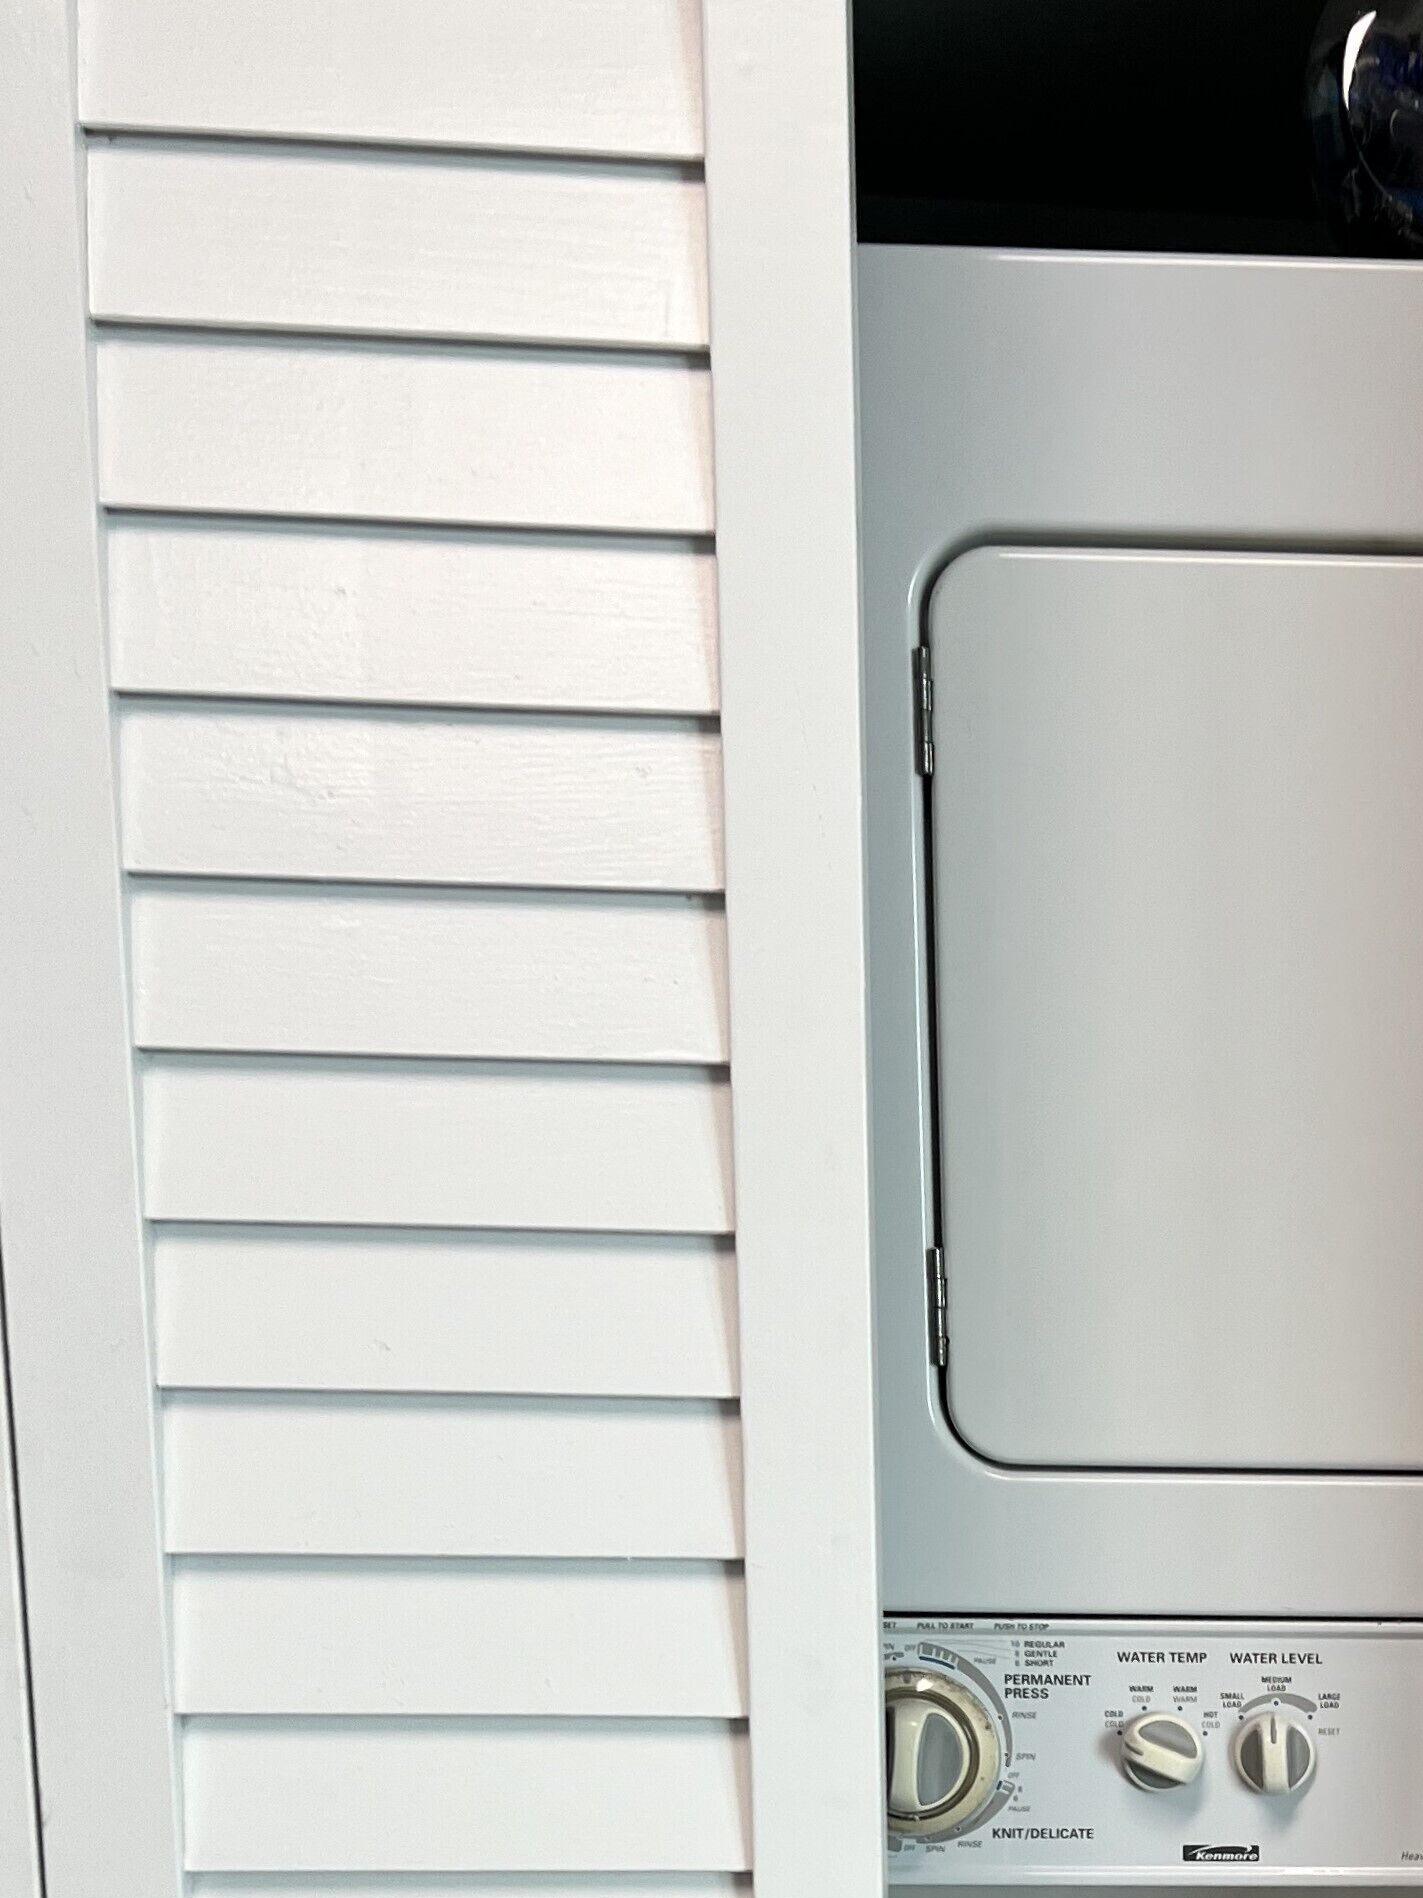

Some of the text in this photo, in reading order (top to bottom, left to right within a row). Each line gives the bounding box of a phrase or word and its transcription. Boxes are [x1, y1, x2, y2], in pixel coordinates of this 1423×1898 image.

[917, 1622, 974, 1630] PULL TO START
[1024, 1650, 1058, 1658] GENTLE
[1117, 1651, 1208, 1663] WATER TEMP
[1229, 1652, 1323, 1664] WATER LEVEL
[1024, 1659, 1054, 1667] SHORT
[1004, 1674, 1092, 1686] PERMANENT
[1261, 1676, 1292, 1684] MEDIUM
[1129, 1685, 1154, 1693] WARM
[1173, 1685, 1198, 1693] WARM
[1004, 1688, 1050, 1699] PRESS
[1318, 1693, 1341, 1701] LARGE
[1132, 1695, 1151, 1703] COLD
[1173, 1695, 1198, 1703] WARM
[1222, 1701, 1242, 1709] LOAD
[1320, 1701, 1340, 1709] LOAD
[1012, 1711, 1037, 1719] RINSE
[1104, 1710, 1124, 1718] COLD
[1203, 1711, 1218, 1719] HOT
[1104, 1720, 1124, 1728] COLD
[1318, 1728, 1340, 1736] RESET
[1015, 1752, 1036, 1761] SPIN
[992, 1828, 1094, 1840] KNIT/DELICATE
[957, 1840, 983, 1849] RINSE
[926, 1845, 946, 1853] SPIN
[1195, 1850, 1259, 1862] Kenmore
